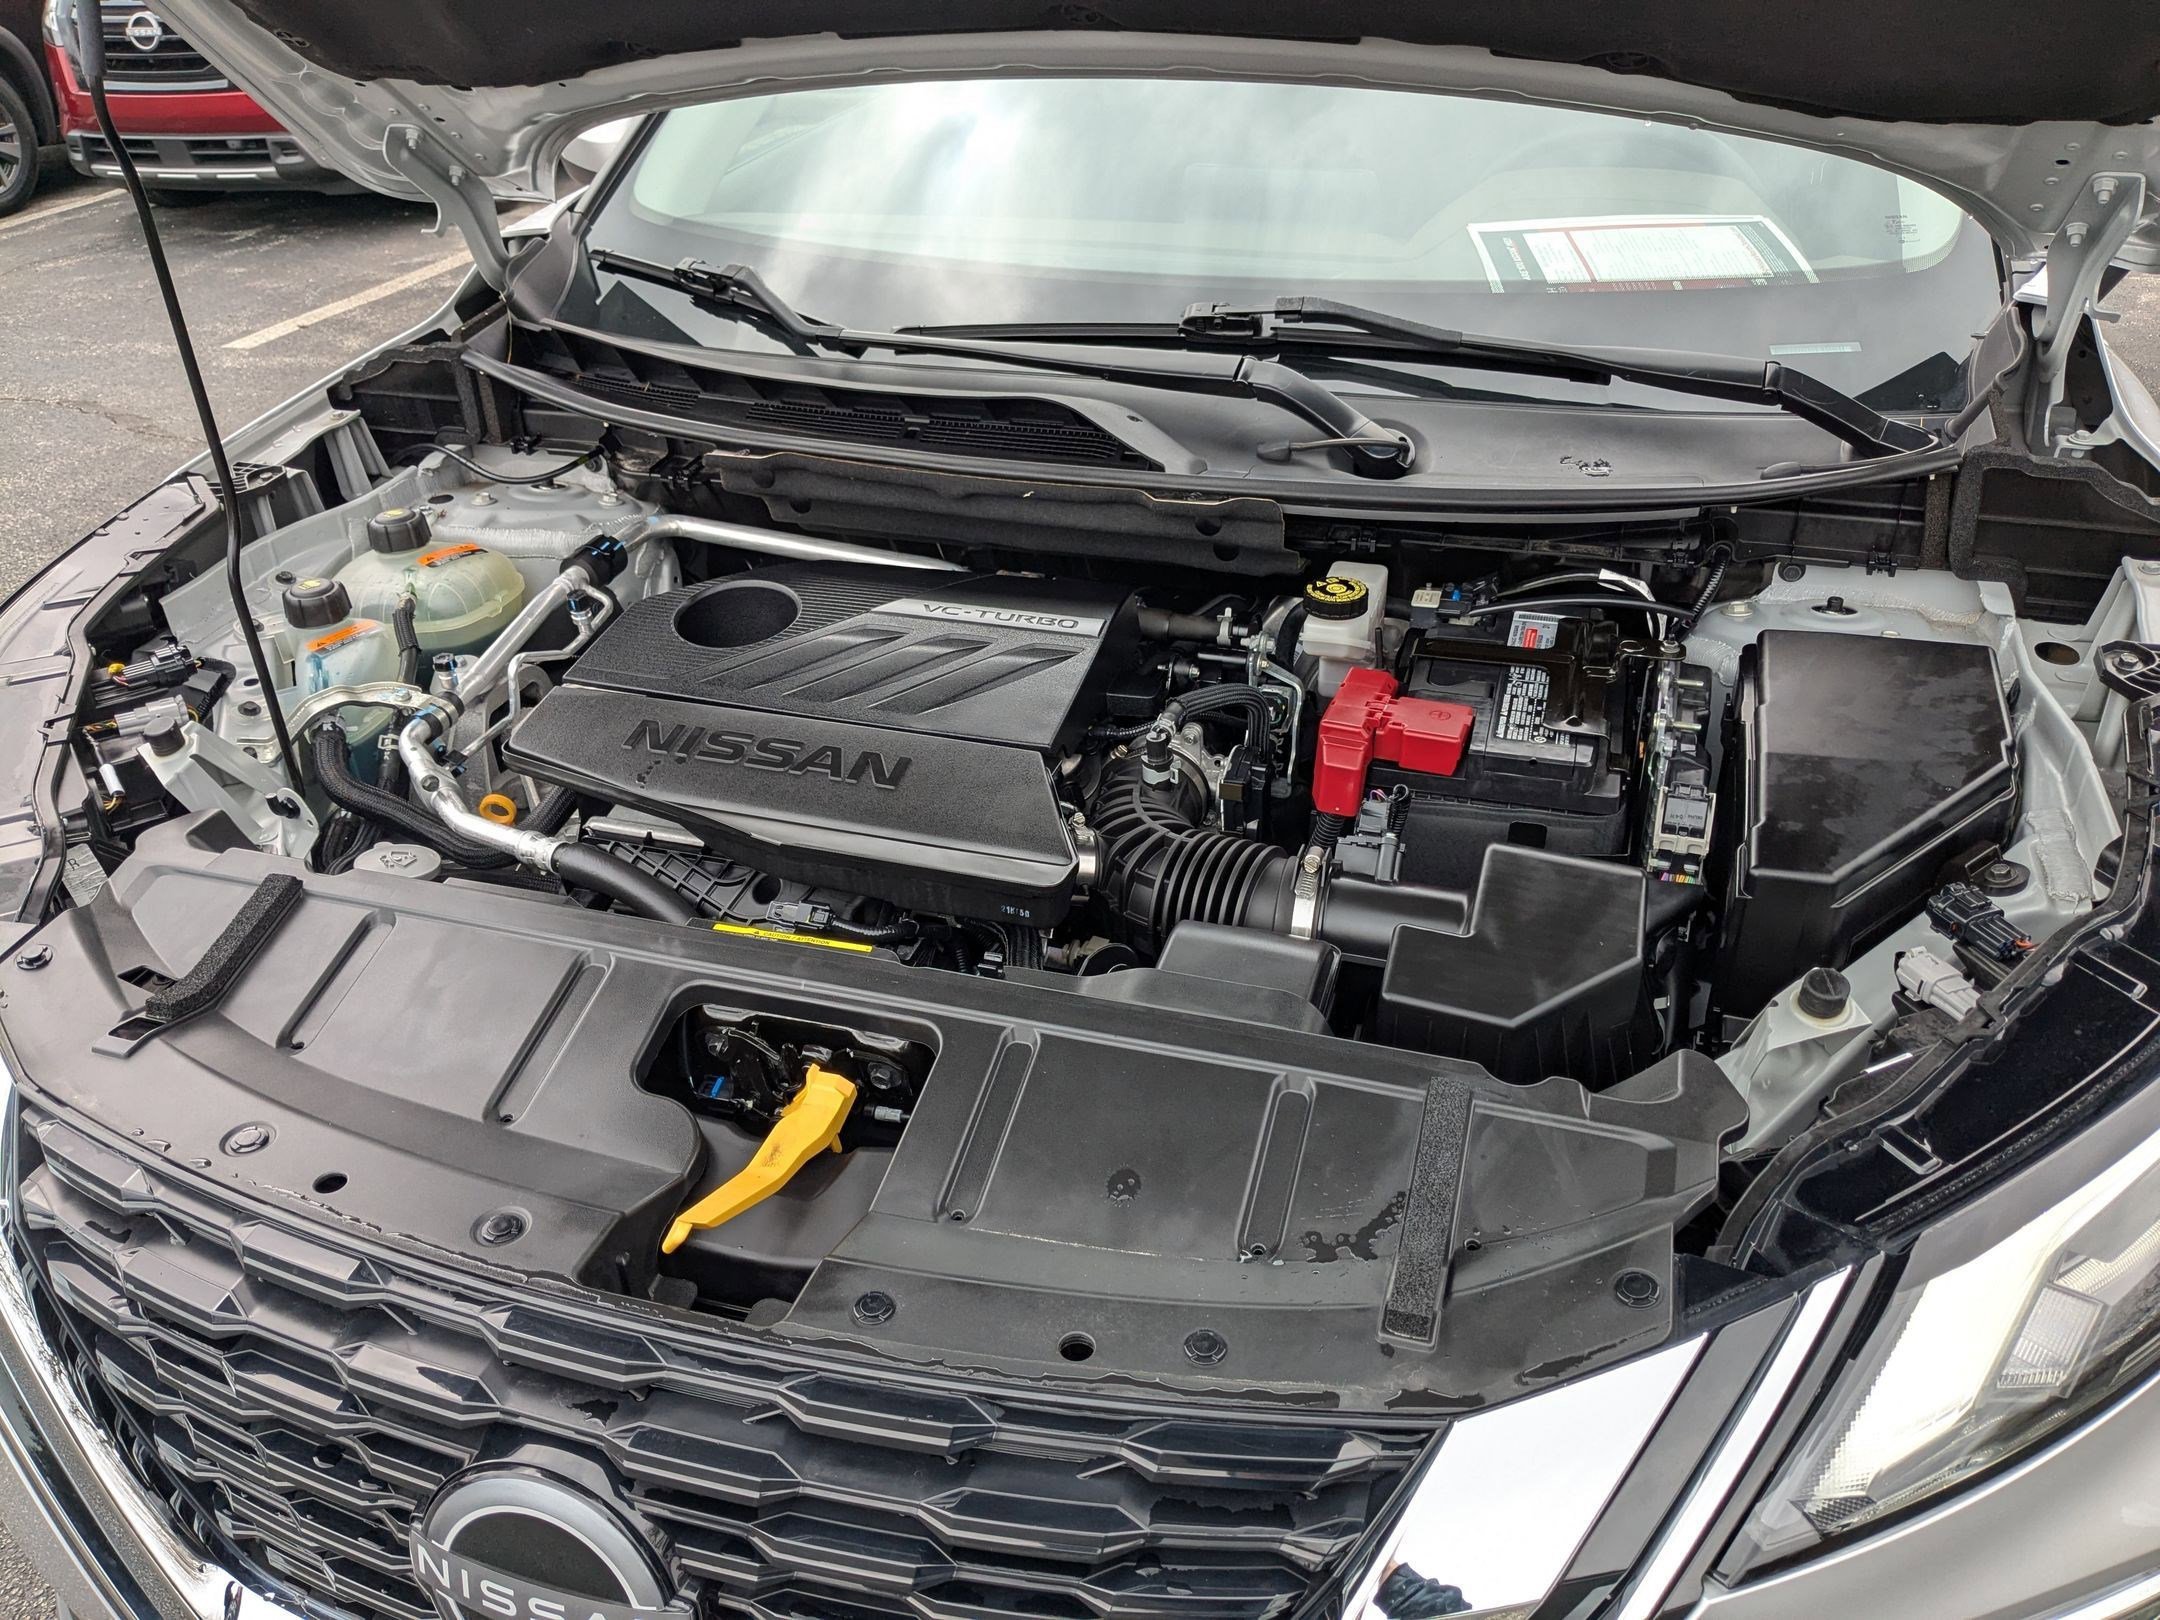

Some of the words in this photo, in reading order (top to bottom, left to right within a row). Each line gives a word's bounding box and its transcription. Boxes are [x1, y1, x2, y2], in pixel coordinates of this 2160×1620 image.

[621, 719, 912, 789] NISSAN
[763, 932, 791, 940] CAUTION
[797, 936, 831, 945] ATTENTION
[417, 1543, 643, 1620] NISS
